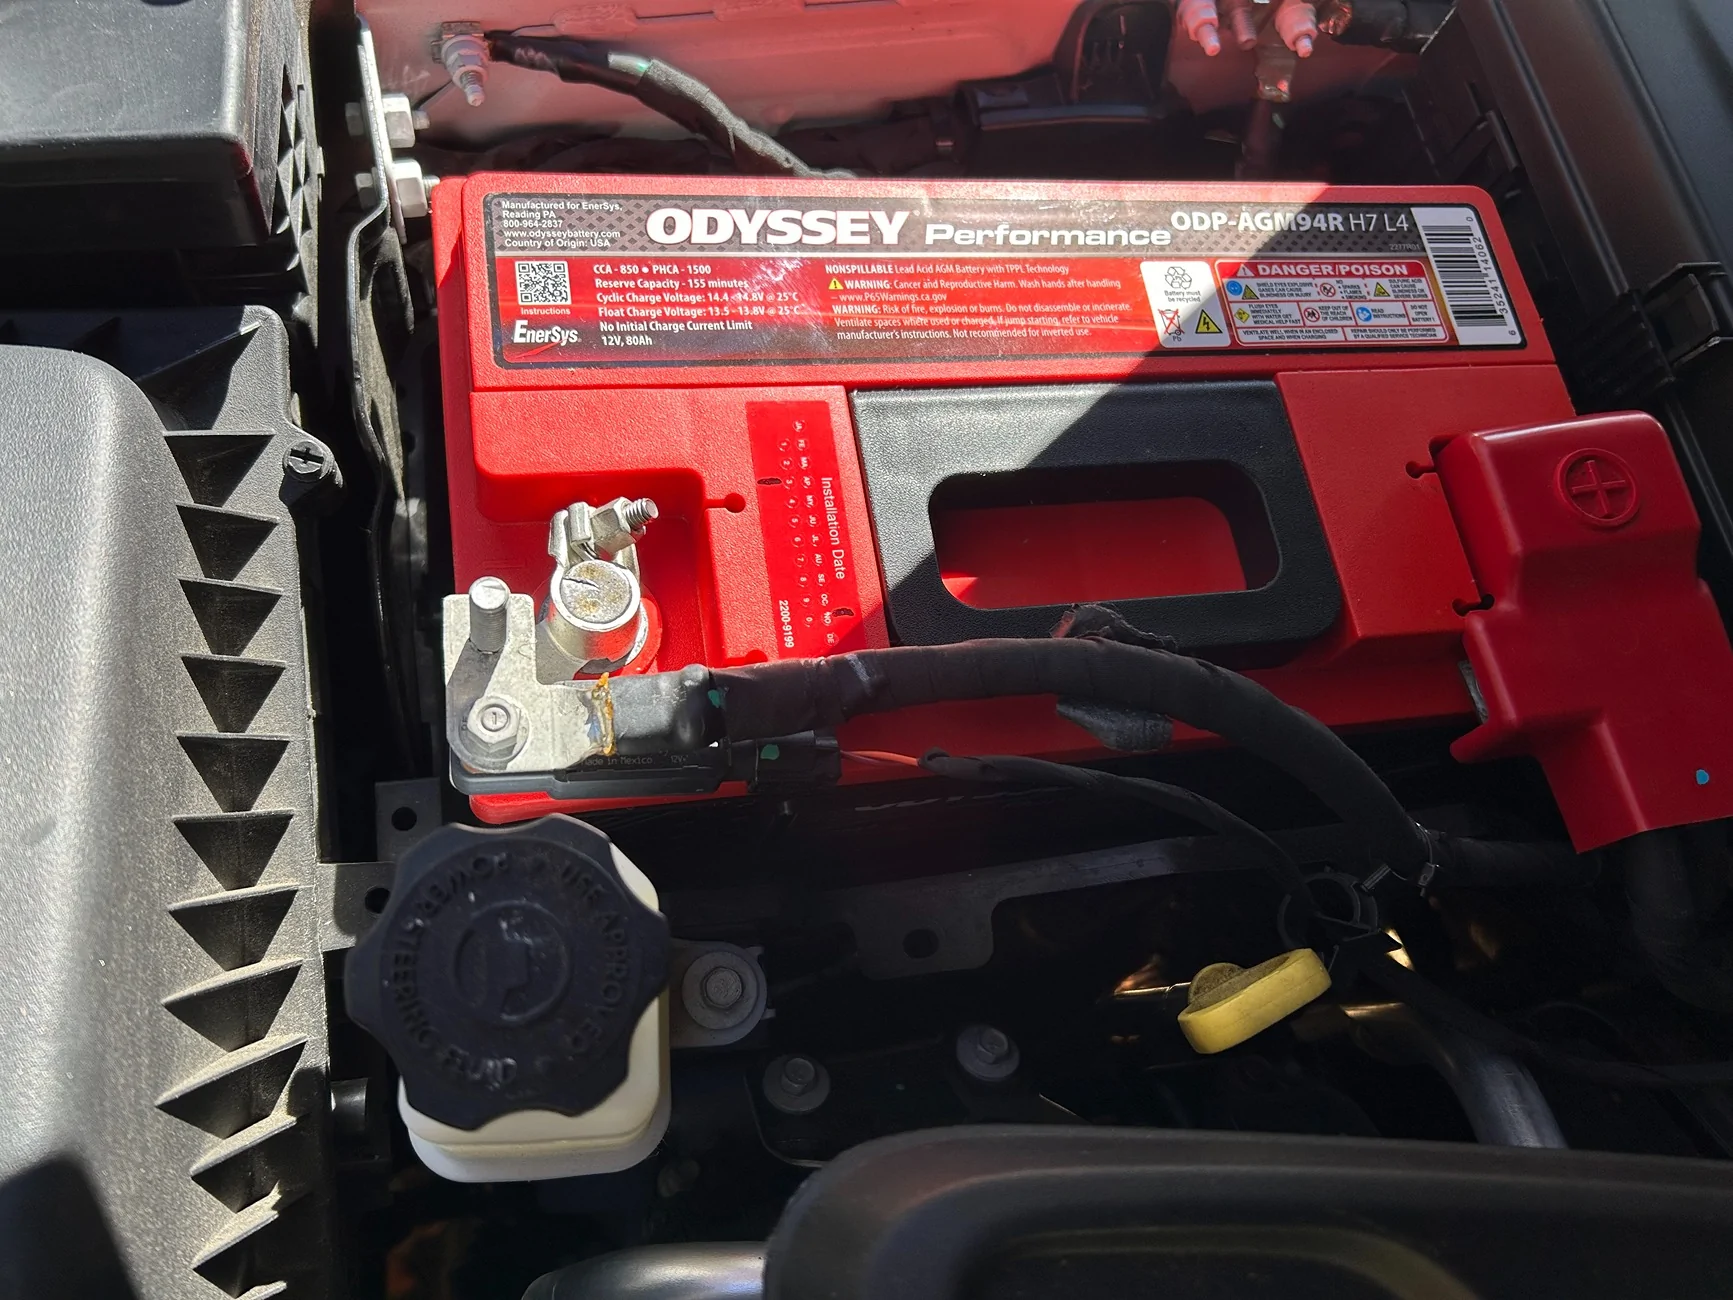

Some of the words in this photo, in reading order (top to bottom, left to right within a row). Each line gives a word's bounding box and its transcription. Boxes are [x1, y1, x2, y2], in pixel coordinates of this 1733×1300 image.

[501, 201, 564, 210] Manufactured
[567, 201, 580, 210] for
[502, 210, 540, 220] Reading
[503, 220, 563, 228] 800-964-2837
[646, 208, 910, 246] ODYSSEY
[1170, 212, 1344, 232] ODP-AGM94R
[1350, 214, 1377, 232] H7
[1384, 214, 1409, 232] L4
[504, 230, 621, 240] www.odysseybattery.com
[925, 224, 1172, 246] Performance
[505, 239, 541, 248] Country
[544, 239, 554, 247] of
[556, 239, 588, 249] Origin:
[590, 240, 611, 248] USA
[1472, 236, 1492, 272] 14062
[593, 264, 613, 274] CCA
[620, 264, 640, 274] 850
[652, 264, 680, 274] PHCA
[686, 264, 712, 274] 1500
[825, 264, 894, 274] NONSPILLABLE
[894, 264, 914, 274] Lead
[916, 264, 934, 274] Acid
[935, 264, 954, 274] AGM
[955, 264, 985, 275] Battery
[986, 264, 1004, 274] with
[1005, 264, 1025, 274] TPPL
[1025, 264, 1069, 275] Technology
[1256, 264, 1408, 276] DANGER/POISON
[595, 278, 636, 288] Reserve
[637, 278, 680, 290] Capacity
[688, 278, 706, 288] 155
[708, 278, 750, 288] minutes
[844, 280, 892, 290] WARNING:
[894, 280, 921, 289] Cancer
[922, 279, 939, 289] and
[940, 279, 992, 291] Reproductive
[993, 279, 1018, 289] Harm.
[1018, 279, 1040, 288] Wash
[1041, 278, 1066, 288] hands
[1067, 278, 1086, 288] after
[1086, 278, 1122, 290] handling
[596, 292, 625, 304] Cyclic
[626, 292, 662, 304] Charge
[662, 292, 706, 304] Voltage:
[707, 292, 729, 302] 14.4
[737, 292, 764, 302] 14.8V
[776, 292, 799, 302] 25°C
[838, 292, 948, 304] www.P65Warnings.ca.gov
[1488, 279, 1508, 314] 35241
[520, 307, 571, 315] Instructions
[598, 307, 625, 317] Float
[626, 307, 662, 319] Charge
[664, 307, 706, 319] Voltage:
[708, 306, 730, 316] 13.5
[738, 306, 765, 316] 13.8V
[778, 306, 800, 316] 25°C
[832, 304, 882, 314] WARNING:
[882, 304, 900, 314] Risk
[901, 304, 910, 314] of
[911, 304, 928, 315] fire,
[929, 304, 968, 316] explosion
[969, 305, 978, 313] or
[978, 303, 1004, 313] burns.
[1006, 303, 1018, 312] Do
[1018, 304, 1032, 312] not
[1033, 302, 1081, 312] disassemble
[1082, 304, 1091, 312] or
[1092, 302, 1132, 312] incinerate.
[600, 321, 614, 332] No
[616, 321, 648, 332] Initial
[649, 320, 685, 333] Charge
[686, 320, 726, 331] Current
[726, 320, 753, 330] Limit
[834, 317, 873, 328] Ventilate
[874, 318, 902, 329] spaces
[902, 316, 929, 326] where
[930, 316, 950, 326] used
[950, 318, 960, 326] or
[1004, 316, 1026, 328] jump
[1027, 316, 1060, 327] starting,
[1062, 314, 1080, 324] refer
[1081, 315, 1090, 324] to
[1092, 314, 1119, 324] vehicle
[513, 320, 579, 346] EnerSys
[837, 329, 900, 340] manufacturer's
[900, 328, 952, 339] instructions.
[952, 328, 969, 338] Not
[969, 328, 1027, 338] recommended
[1028, 327, 1040, 337] for
[1041, 327, 1074, 337] inverted
[1075, 328, 1092, 336] use.
[602, 336, 624, 347] 12V,
[625, 335, 653, 346] 80Ah
[798, 440, 806, 448] FE
[803, 476, 811, 486] AP
[806, 494, 814, 505] MY
[808, 515, 817, 524] JU
[821, 477, 840, 546] Installation
[832, 549, 846, 580] Date
[812, 534, 820, 543] JL
[814, 554, 822, 564] AU
[818, 573, 826, 583] SE
[820, 594, 829, 604] OC
[778, 600, 794, 648] 2200-9199
[826, 633, 834, 644] DE
[607, 756, 618, 765] in
[620, 756, 653, 765] Mexico
